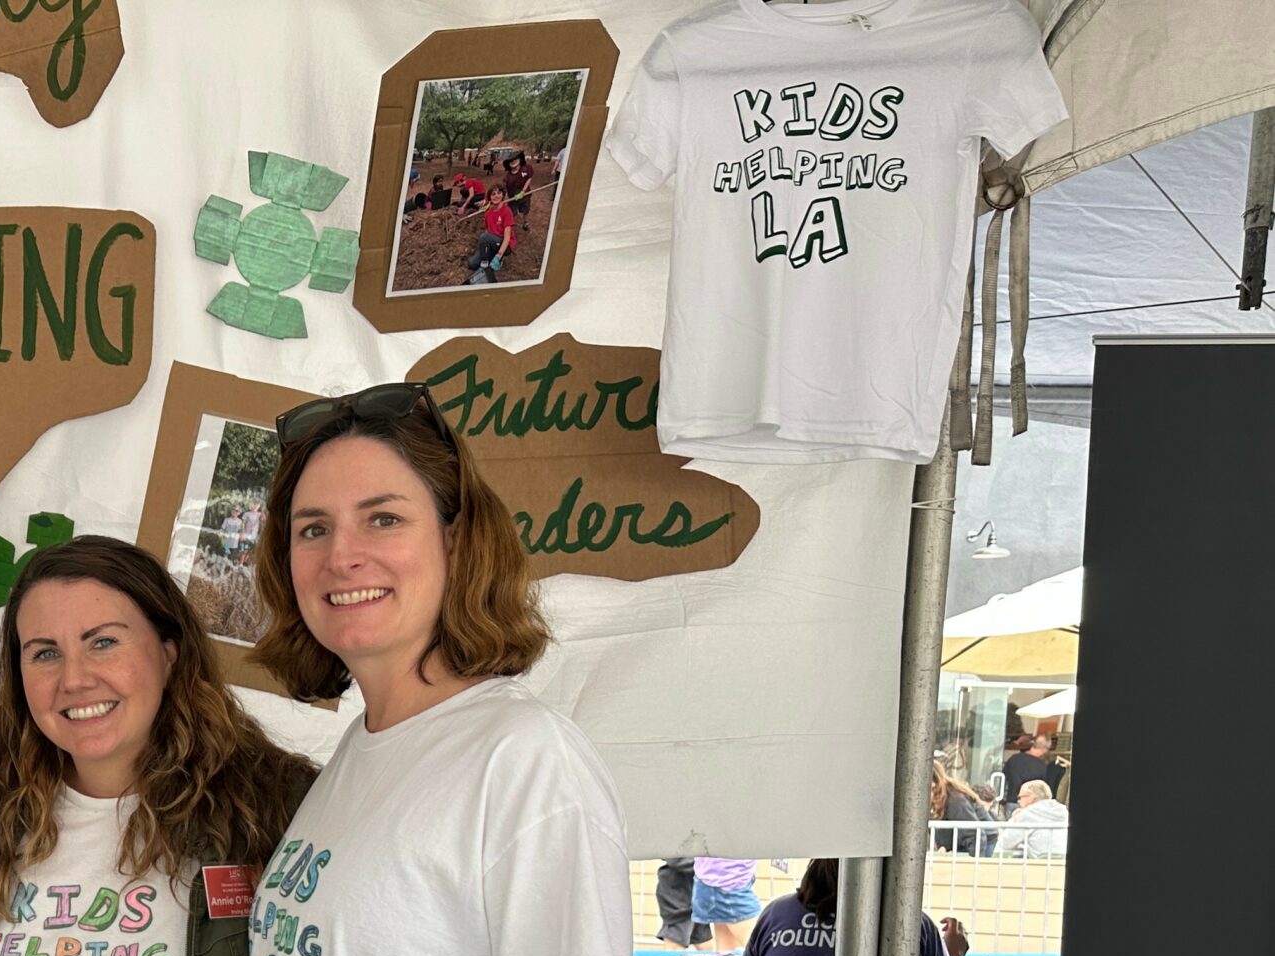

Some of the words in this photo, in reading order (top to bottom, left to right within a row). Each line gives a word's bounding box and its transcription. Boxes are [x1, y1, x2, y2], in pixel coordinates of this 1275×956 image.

[733, 81, 904, 143] KIDS
[713, 146, 907, 192] HELPING
[751, 190, 848, 269] LA
[512, 477, 736, 554] aders
[263, 837, 332, 903] IDS
[10, 881, 157, 933] KIDS
[211, 897, 234, 906] Annie
[236, 895, 254, 904] O'Ro
[770, 918, 837, 948] VOLUN
